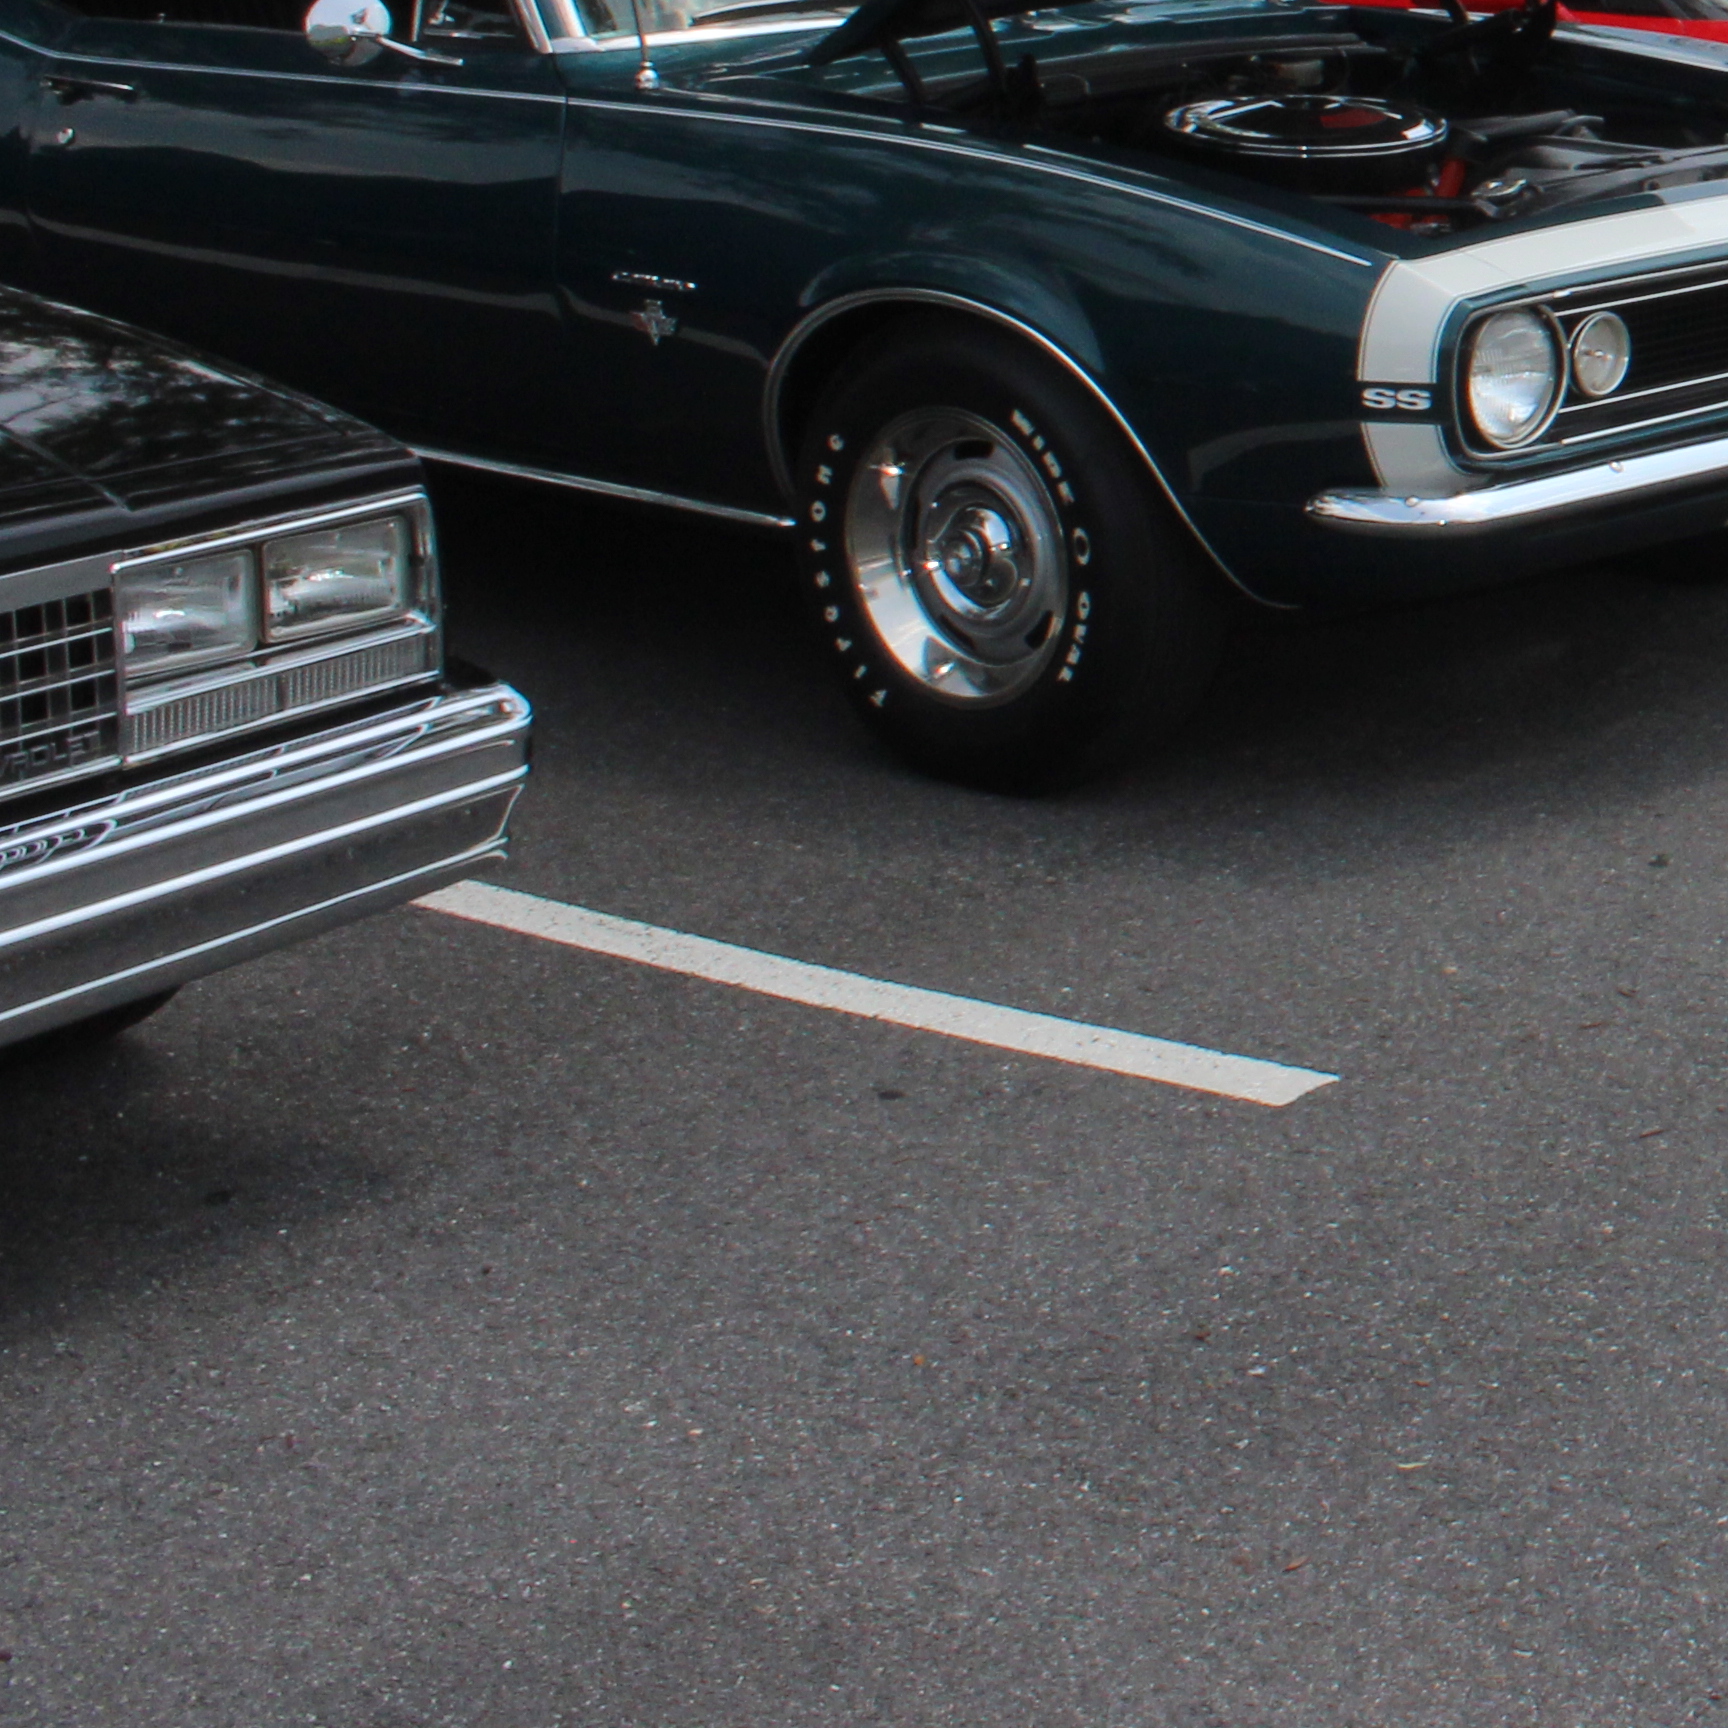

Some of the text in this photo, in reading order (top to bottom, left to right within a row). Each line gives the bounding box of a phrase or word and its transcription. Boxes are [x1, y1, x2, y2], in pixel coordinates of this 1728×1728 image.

[1362, 387, 1433, 411] SS
[1010, 408, 1076, 506] WIDE
[1055, 590, 1091, 683] OVAL
